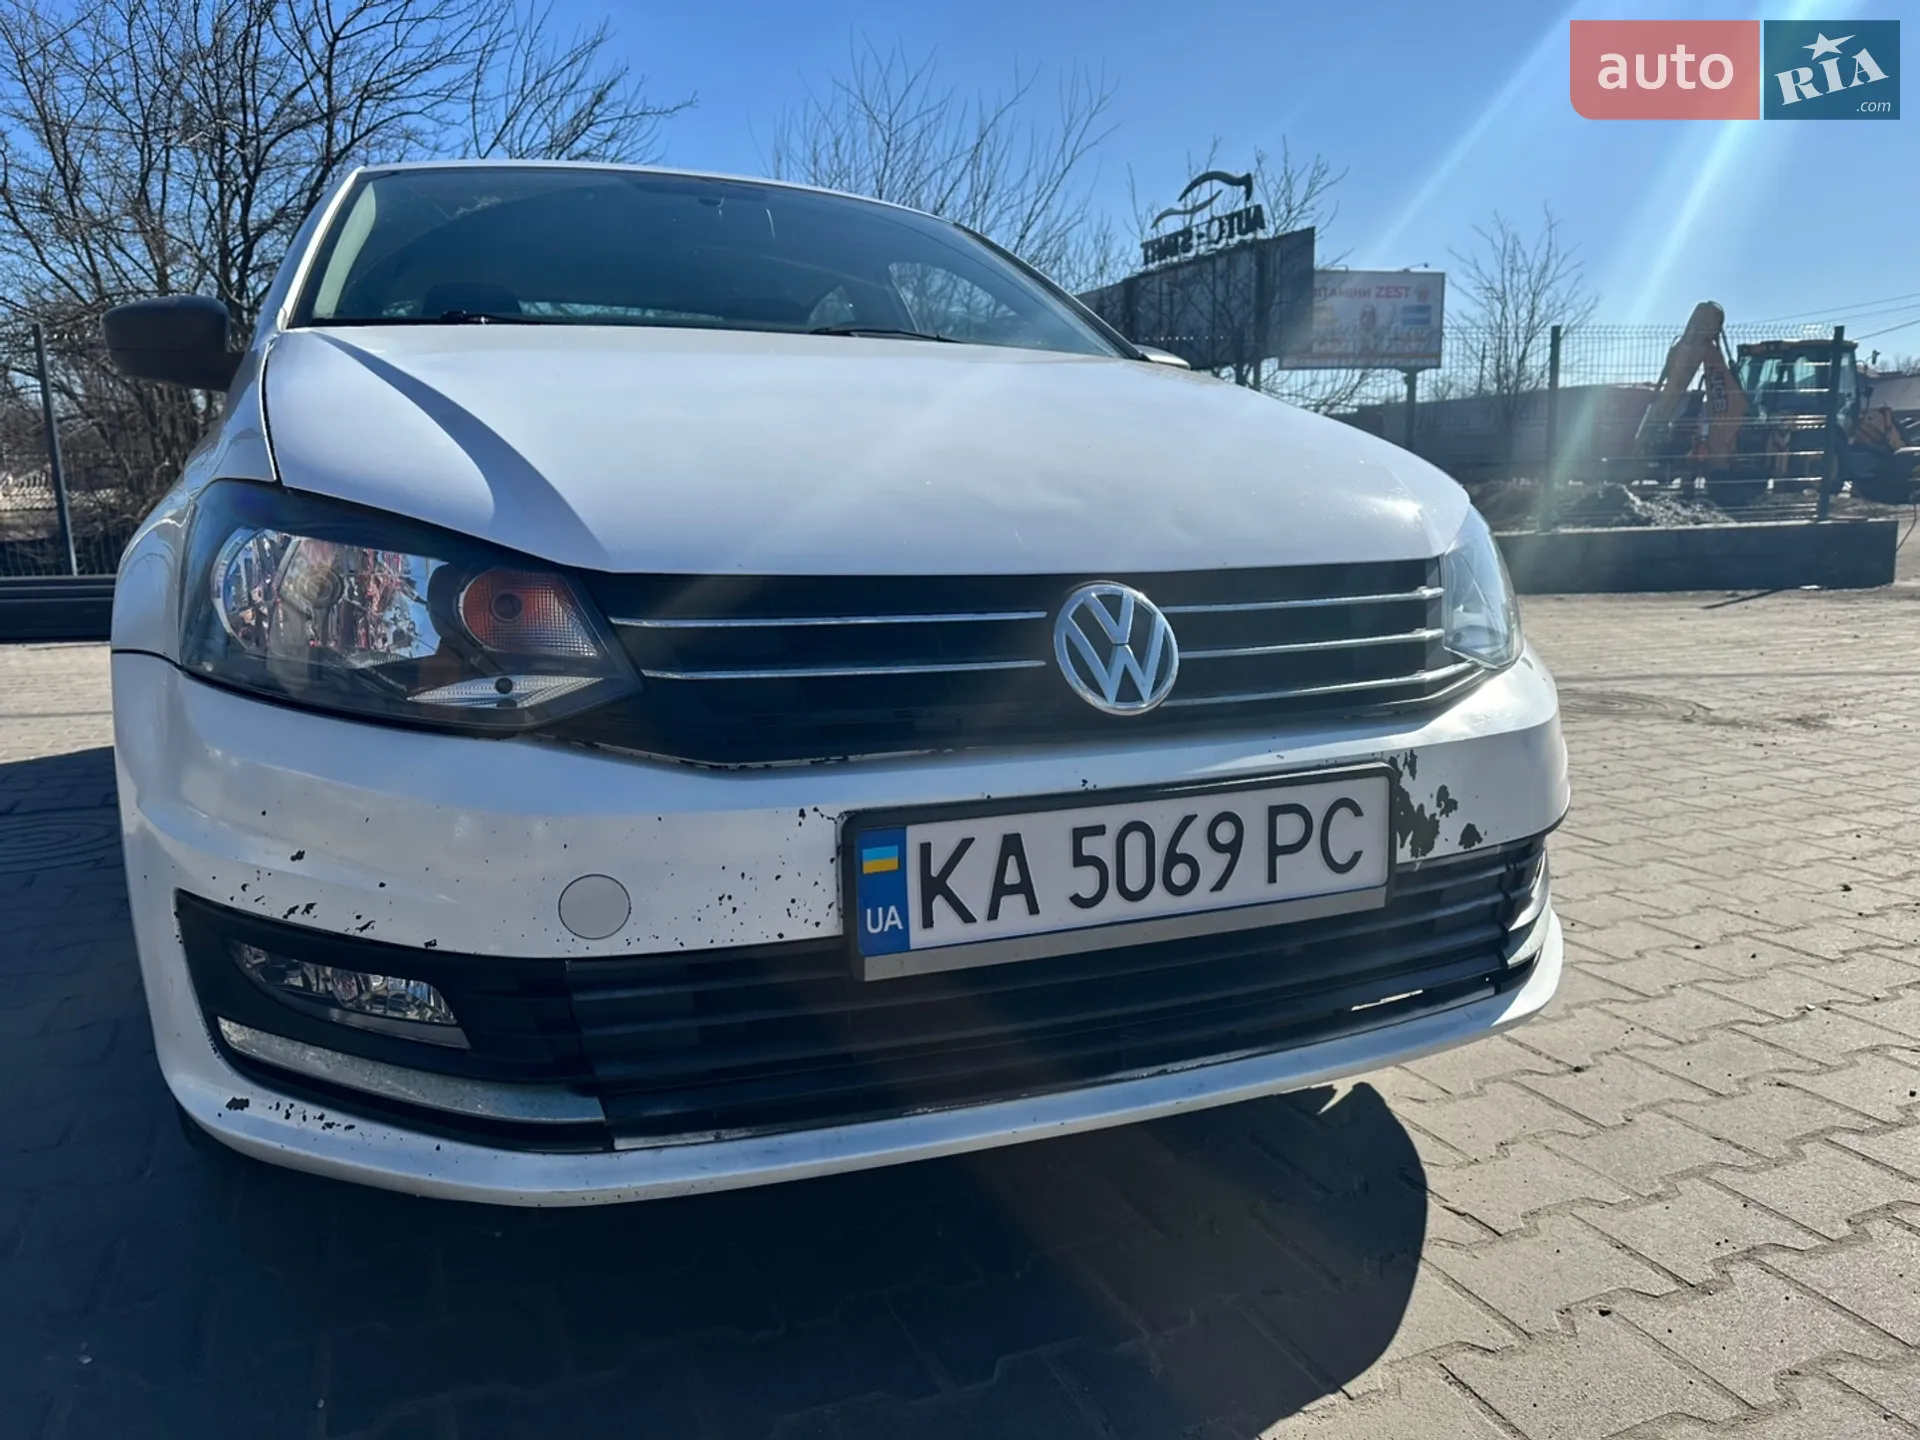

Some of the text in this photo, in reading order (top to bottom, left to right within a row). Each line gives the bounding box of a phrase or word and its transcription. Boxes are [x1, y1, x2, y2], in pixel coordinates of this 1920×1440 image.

[1375, 285, 1412, 300] ZEST
[919, 796, 1365, 930] KA 5069 PC
[865, 905, 904, 934] UA
